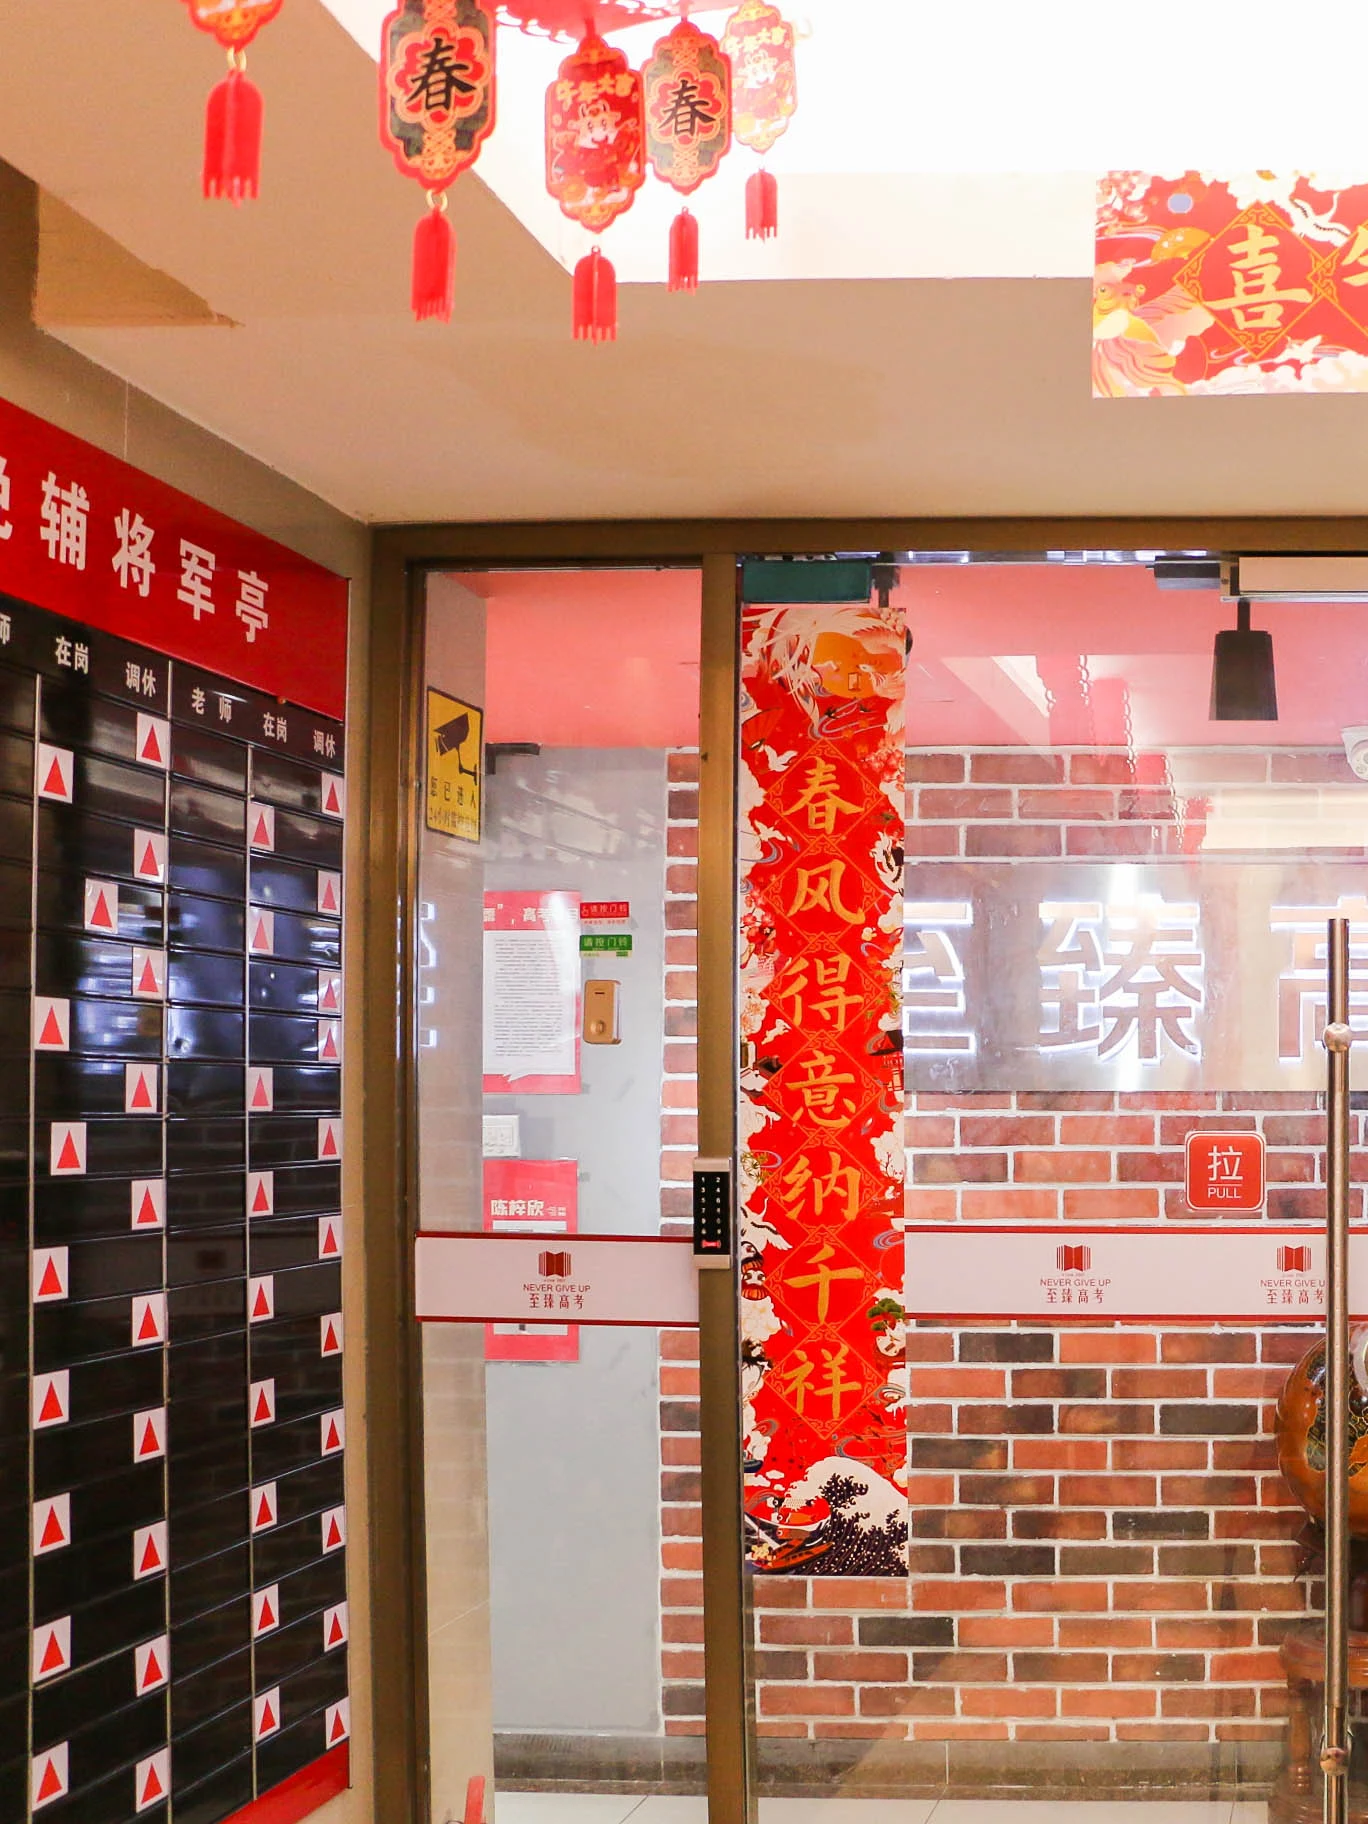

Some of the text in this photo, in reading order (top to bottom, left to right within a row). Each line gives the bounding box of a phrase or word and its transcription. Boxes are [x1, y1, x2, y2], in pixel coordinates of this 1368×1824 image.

[405, 38, 477, 111] 春
[658, 80, 717, 135] 春
[55, 636, 90, 675] 在岗
[125, 662, 157, 698] 调休
[191, 687, 233, 724] 老师
[263, 711, 288, 743] 在岗
[313, 729, 337, 760] 调休
[780, 756, 868, 1421] 春风得意纳千祥
[1207, 1145, 1243, 1181] 拉
[1207, 1187, 1242, 1199] PULL
[523, 1283, 591, 1293] NEVER GIVE UP
[1040, 1278, 1111, 1287] NEVER GIVE UP
[1260, 1279, 1326, 1288] NEVER GIVE U
